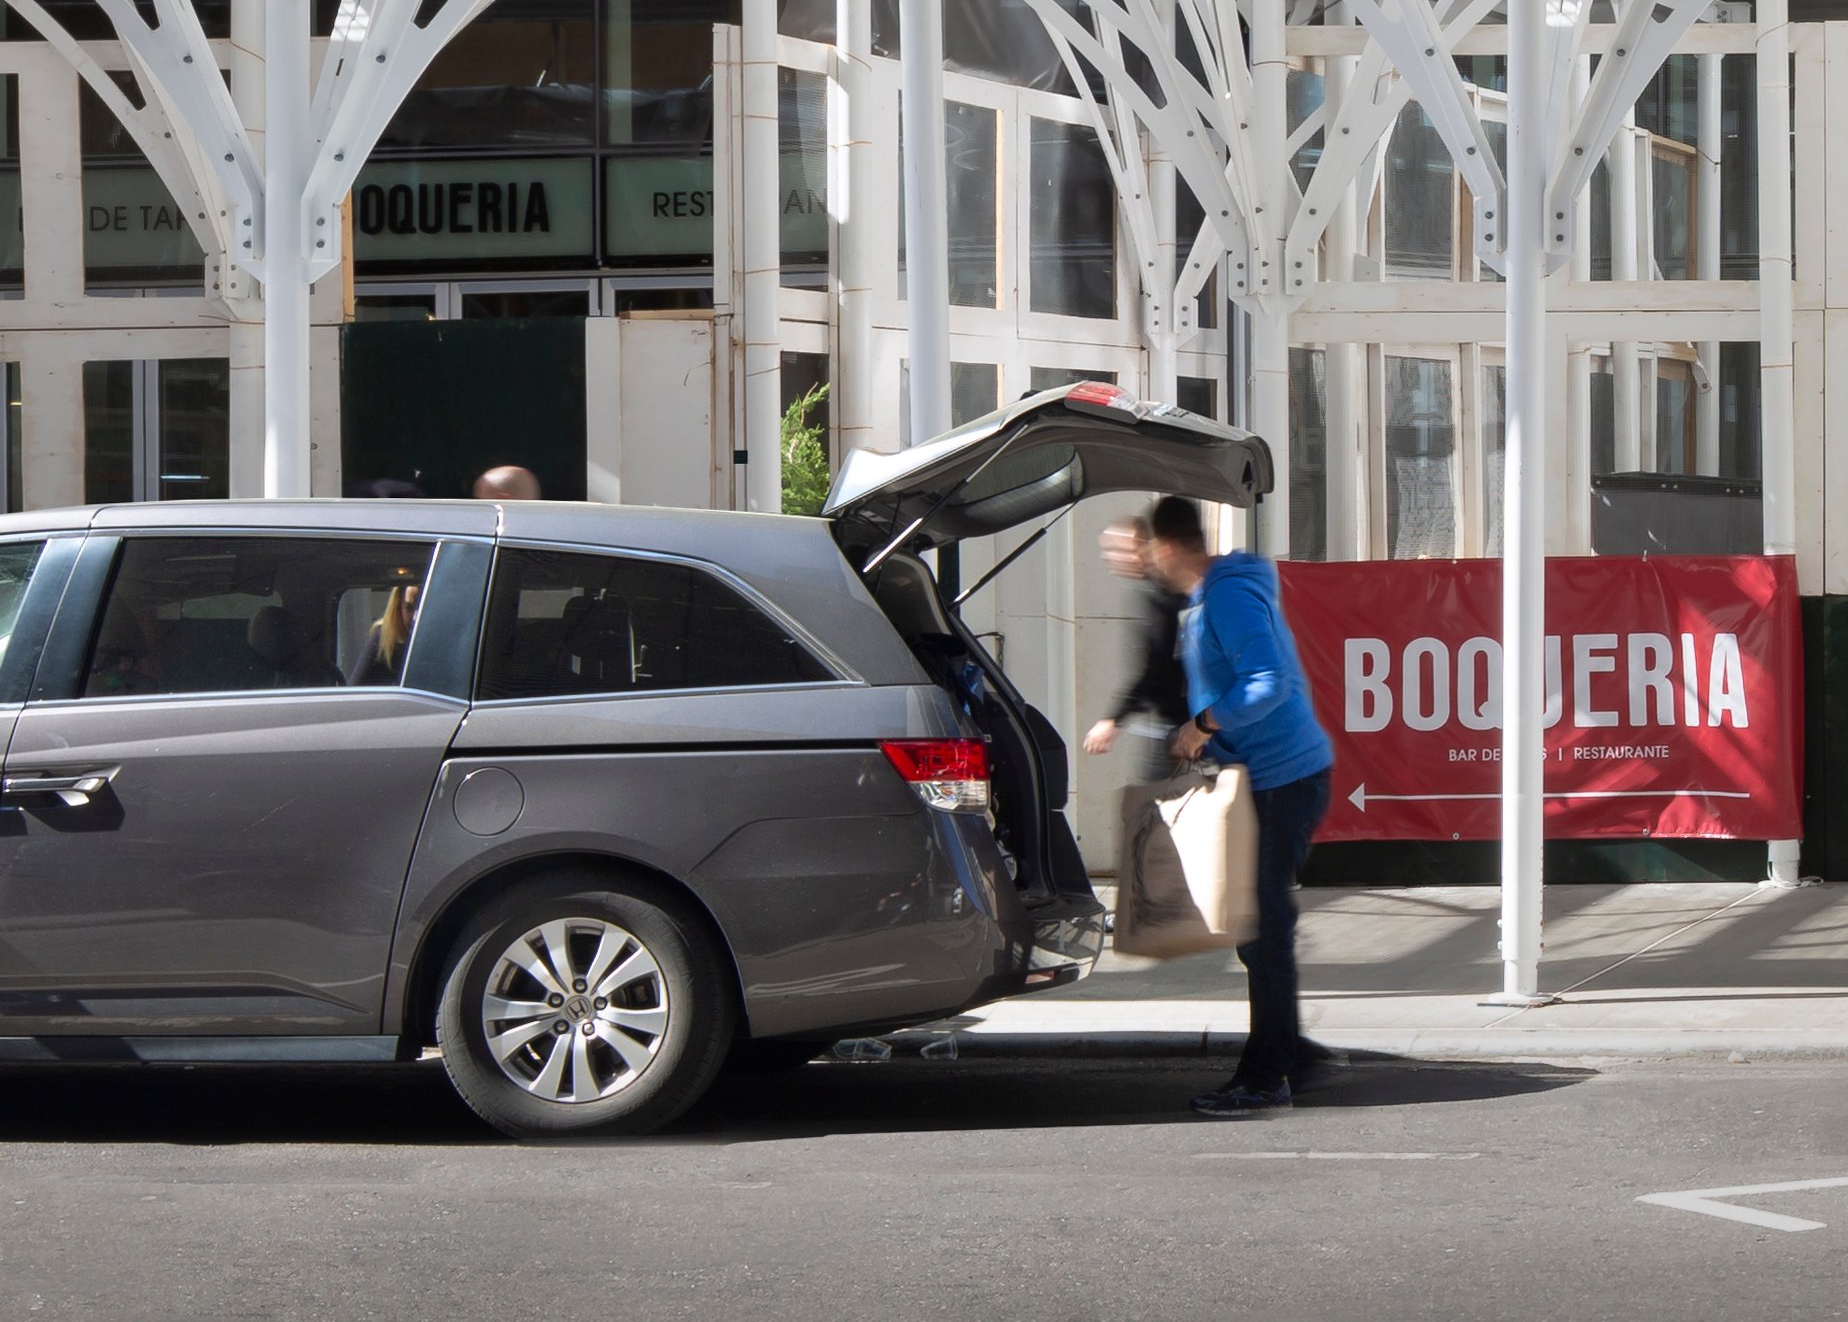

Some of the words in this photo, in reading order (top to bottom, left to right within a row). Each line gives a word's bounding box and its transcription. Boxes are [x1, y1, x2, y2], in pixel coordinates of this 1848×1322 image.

[89, 205, 128, 231] DE
[353, 182, 550, 235] OQUERIA
[1448, 748, 1476, 762] BAR
[1482, 748, 1502, 762] DE
[1573, 744, 1670, 760] RESTAURANTE
